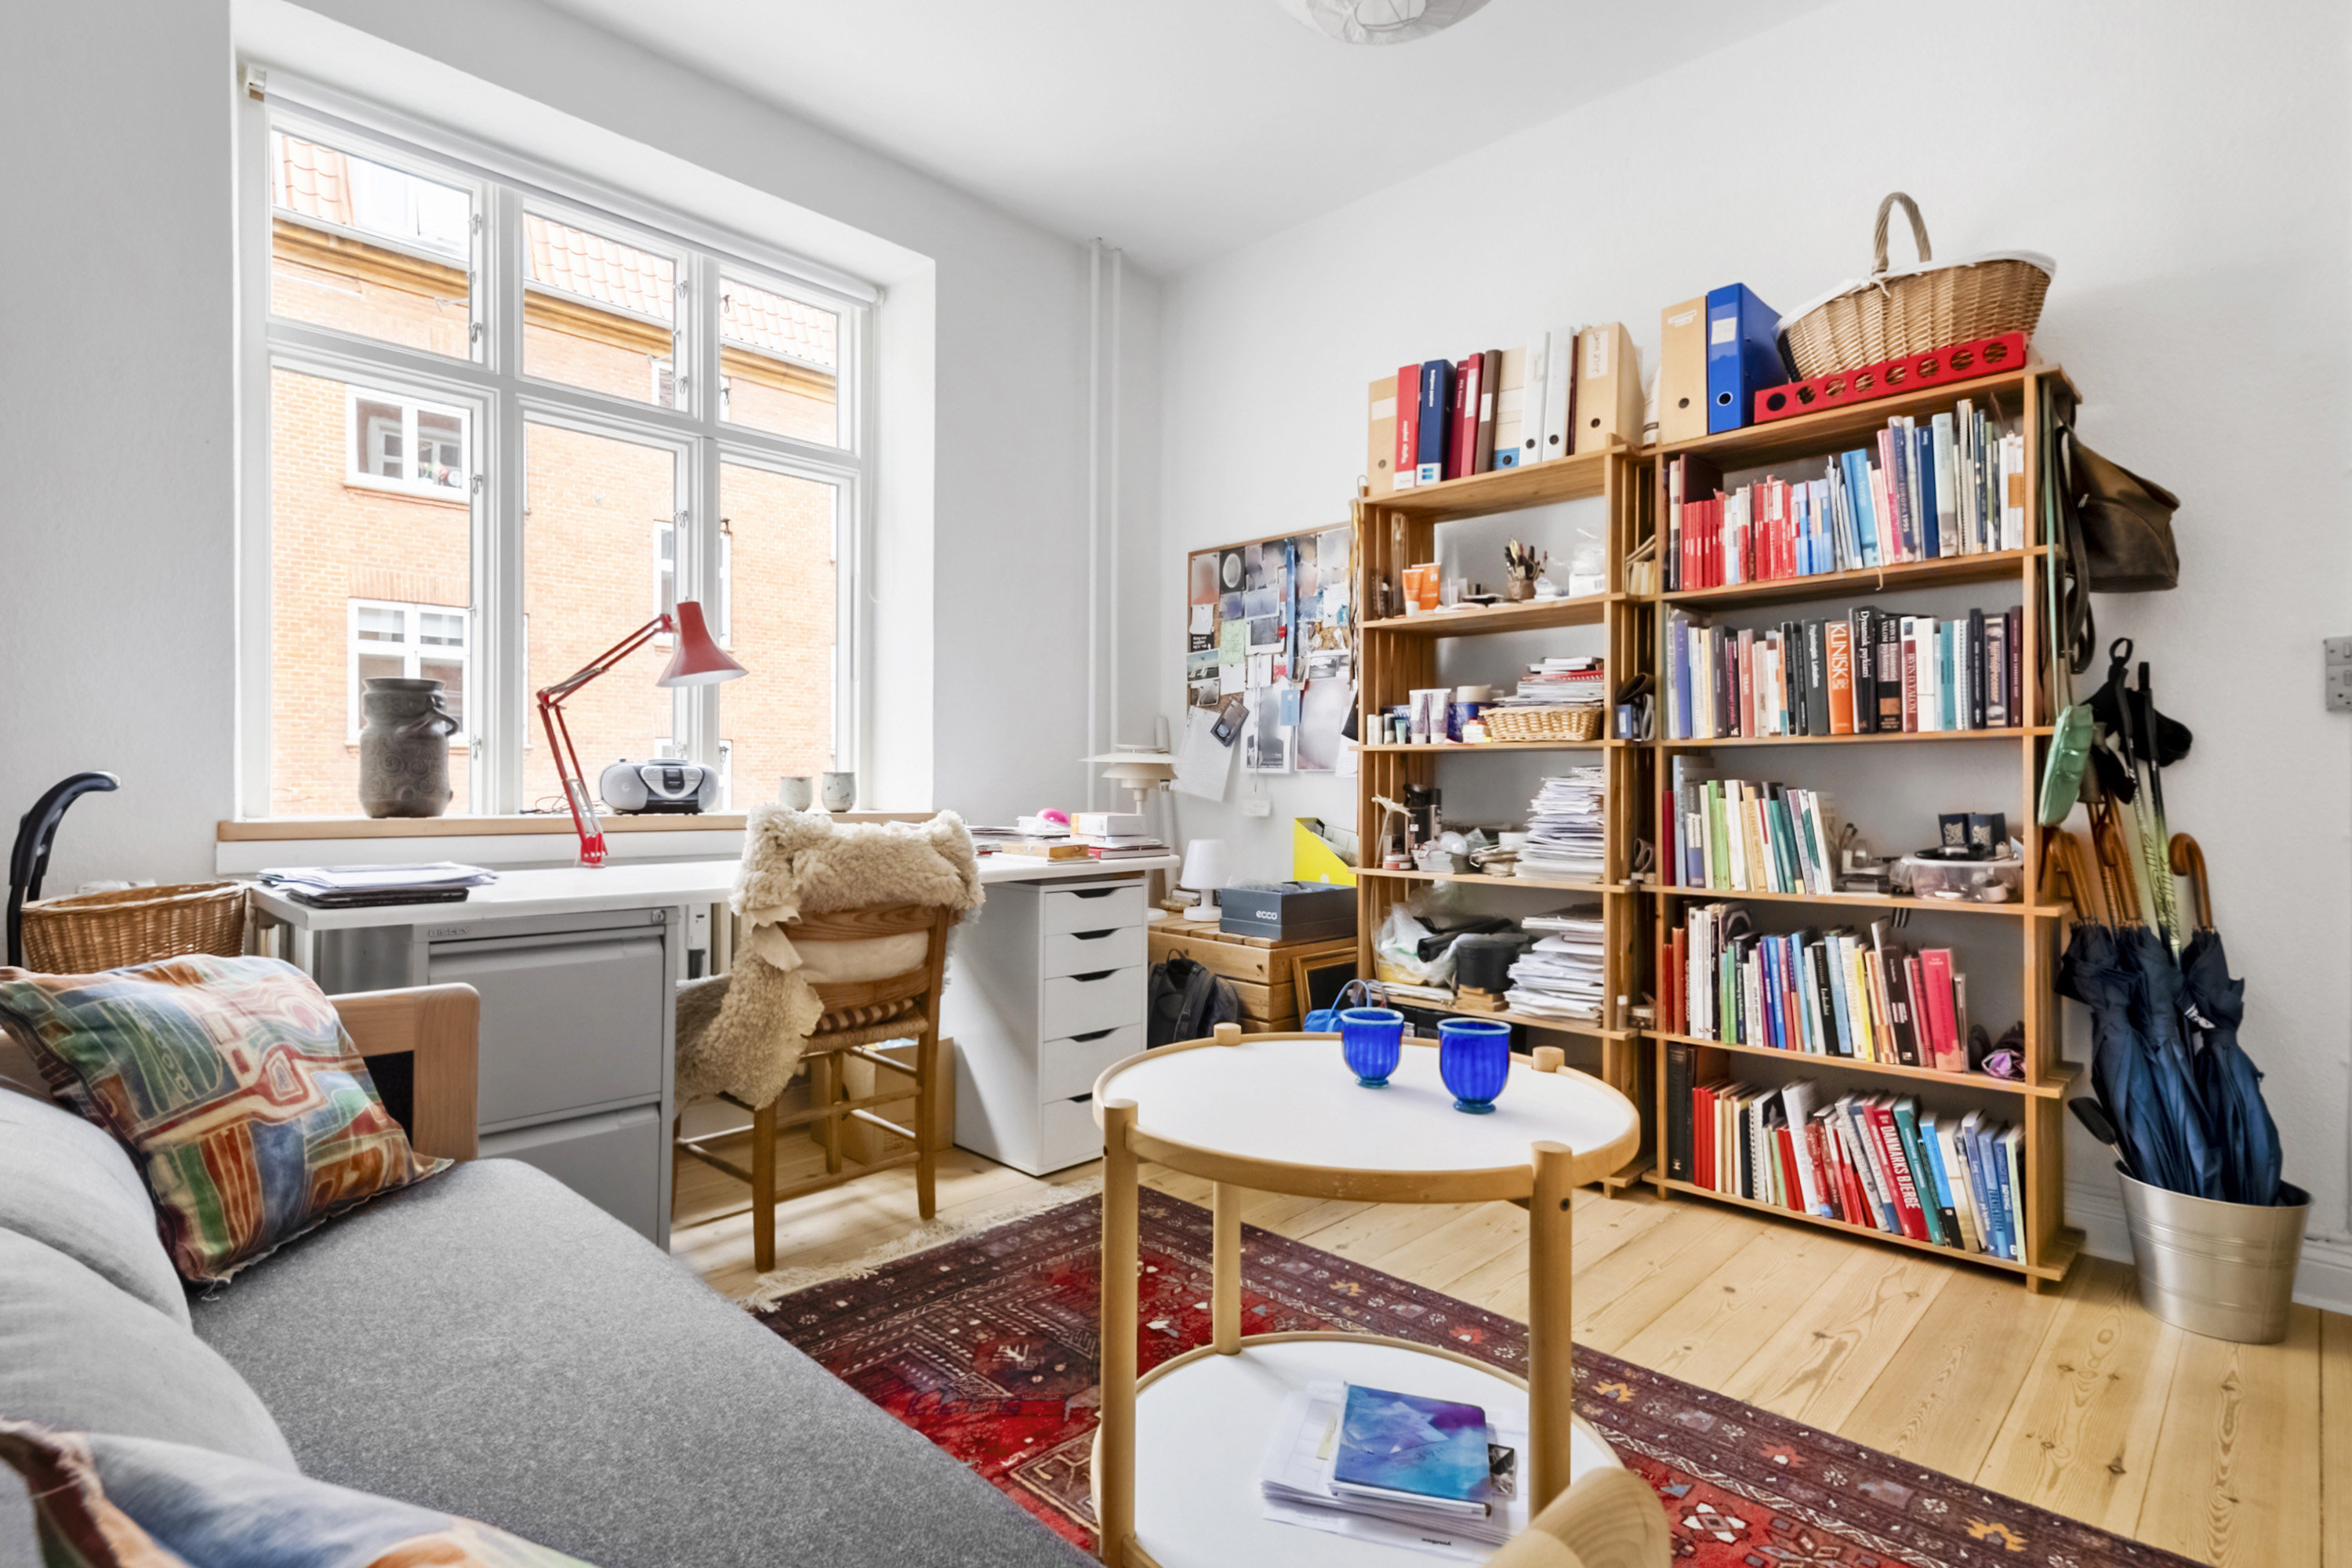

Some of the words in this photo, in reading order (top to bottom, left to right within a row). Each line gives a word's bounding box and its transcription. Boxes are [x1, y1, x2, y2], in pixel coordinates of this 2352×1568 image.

[1898, 482, 1907, 514] EUROPA
[1901, 514, 1910, 532] 1995
[1859, 611, 1871, 648] Dynamisk
[1830, 622, 1849, 679] KLINISK
[1859, 648, 1871, 677] psykiatri
[1907, 653, 1915, 674] IRVIN
[1256, 909, 1277, 920] ecco
[1881, 1126, 1909, 1174] DANMARKS
[1897, 1175, 1920, 1209] BJERGE
[2001, 1184, 2011, 1210] BØVING
